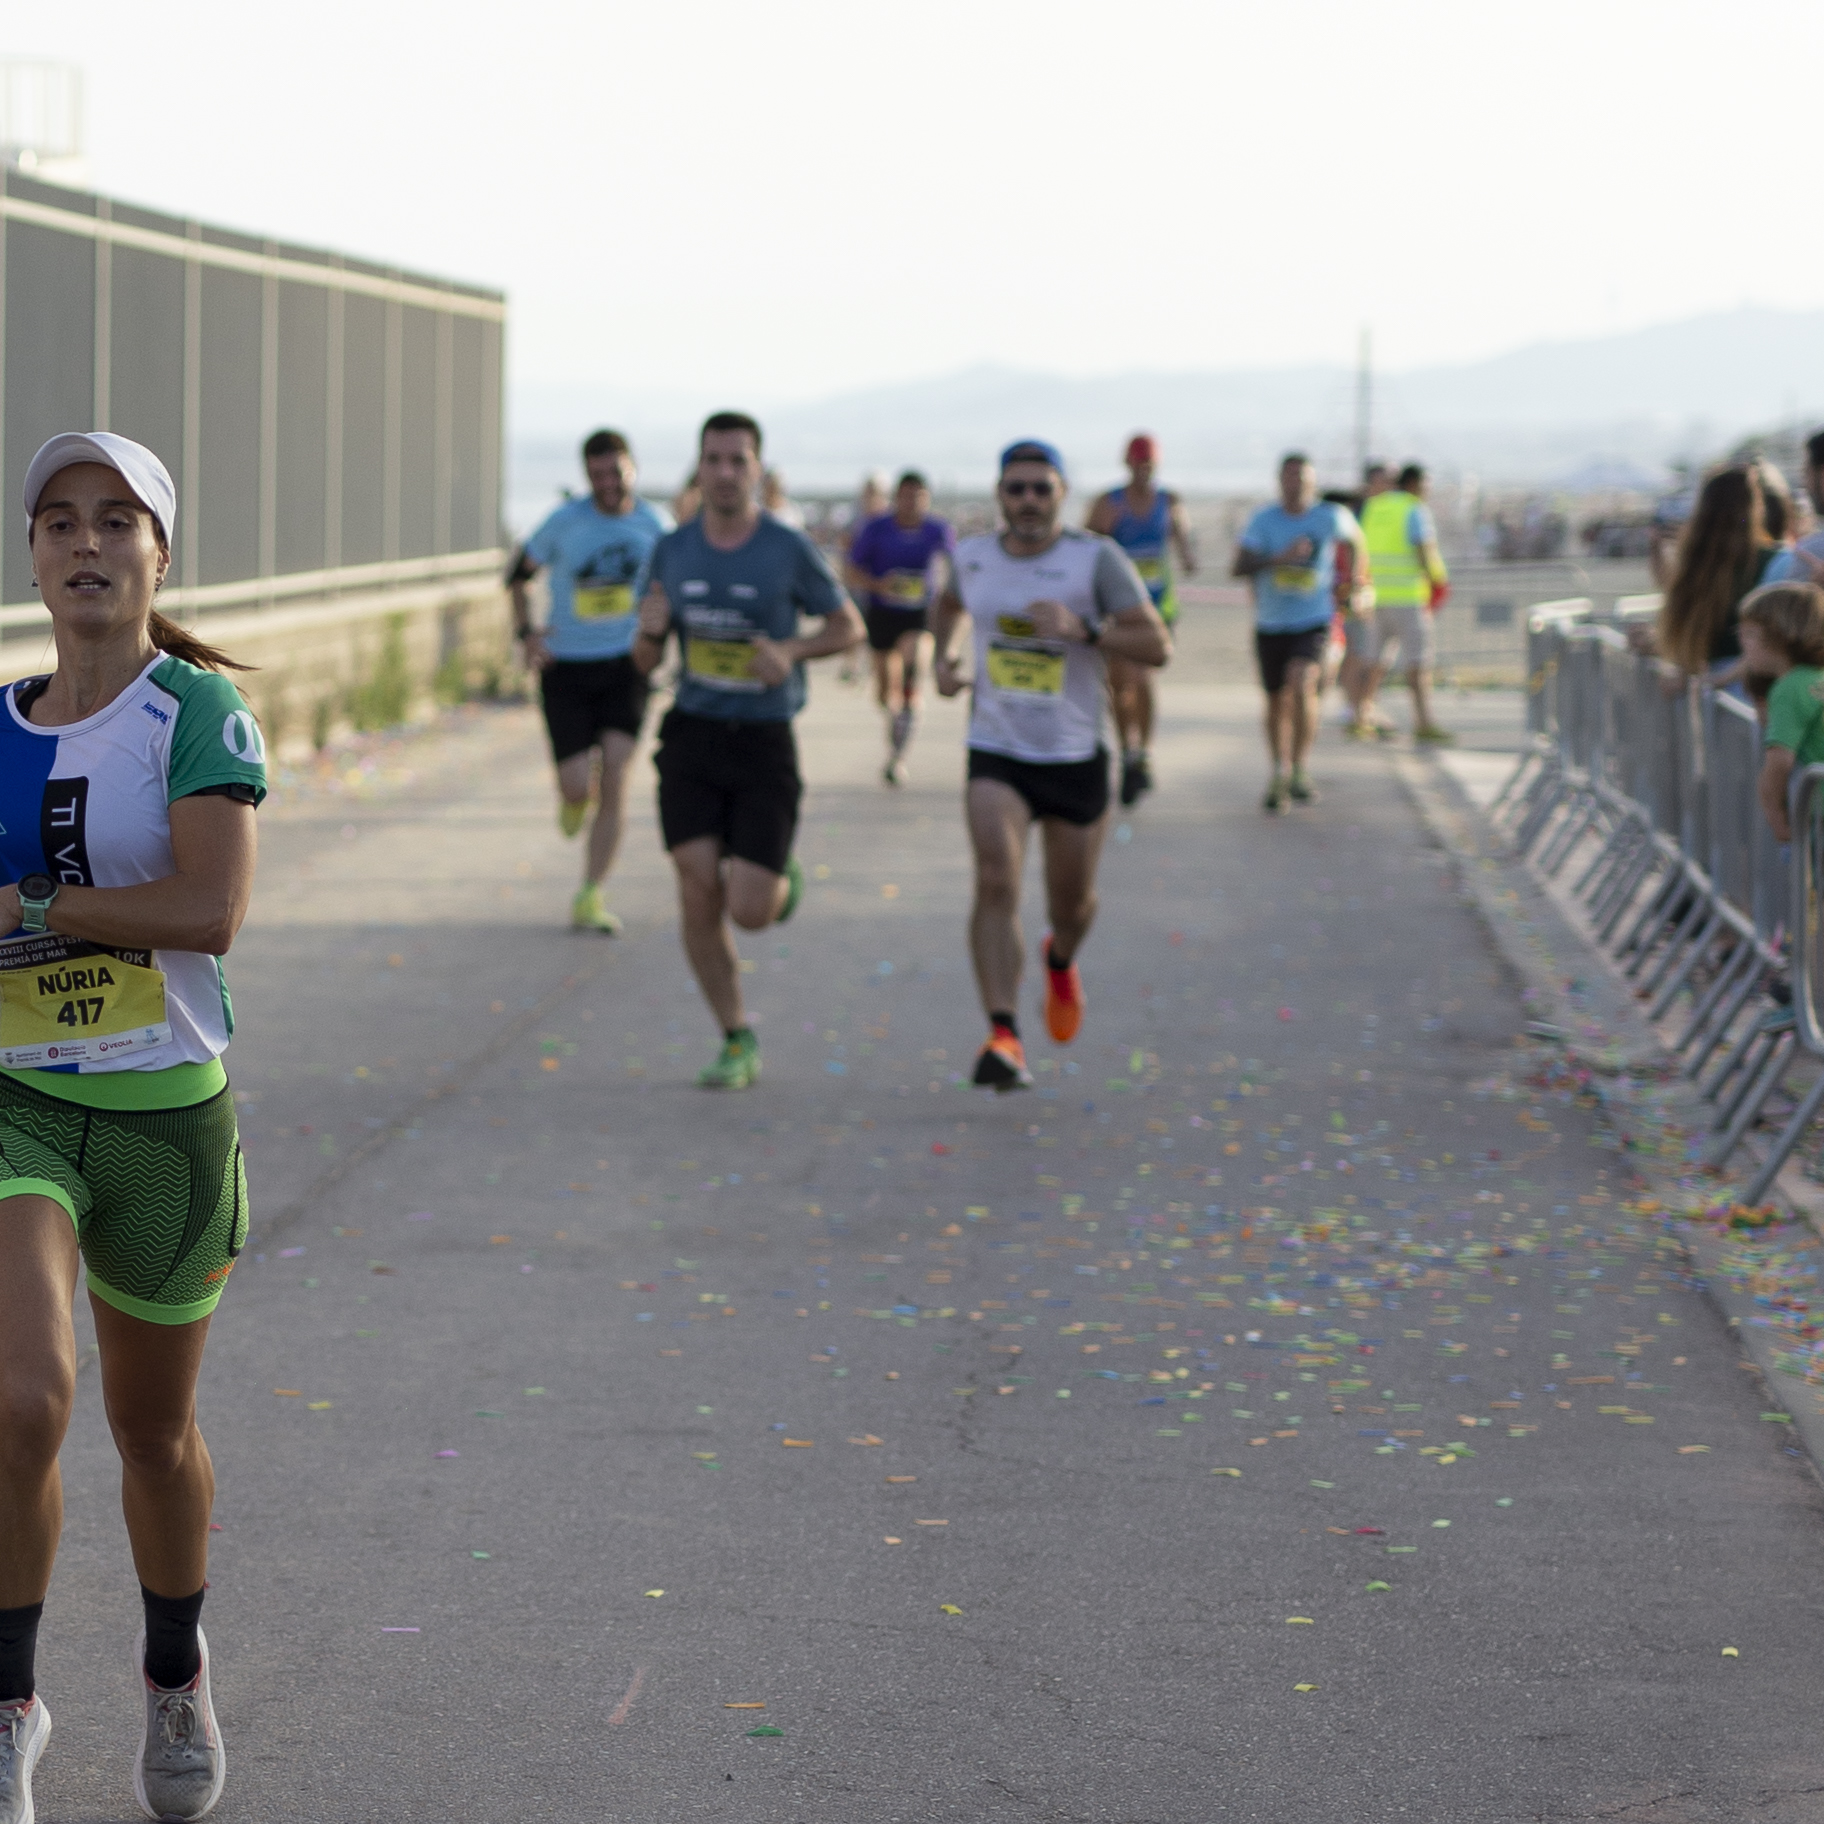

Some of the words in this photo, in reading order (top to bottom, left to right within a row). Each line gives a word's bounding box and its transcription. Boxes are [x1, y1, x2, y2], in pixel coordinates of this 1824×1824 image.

[26, 939, 56, 952] CURSA
[32, 952, 44, 962] DE
[46, 948, 68, 958] MAR
[114, 950, 146, 965] 10K
[37, 966, 115, 996] NÚRIA
[57, 996, 105, 1027] 417
[108, 1039, 133, 1049] VEOLIA
